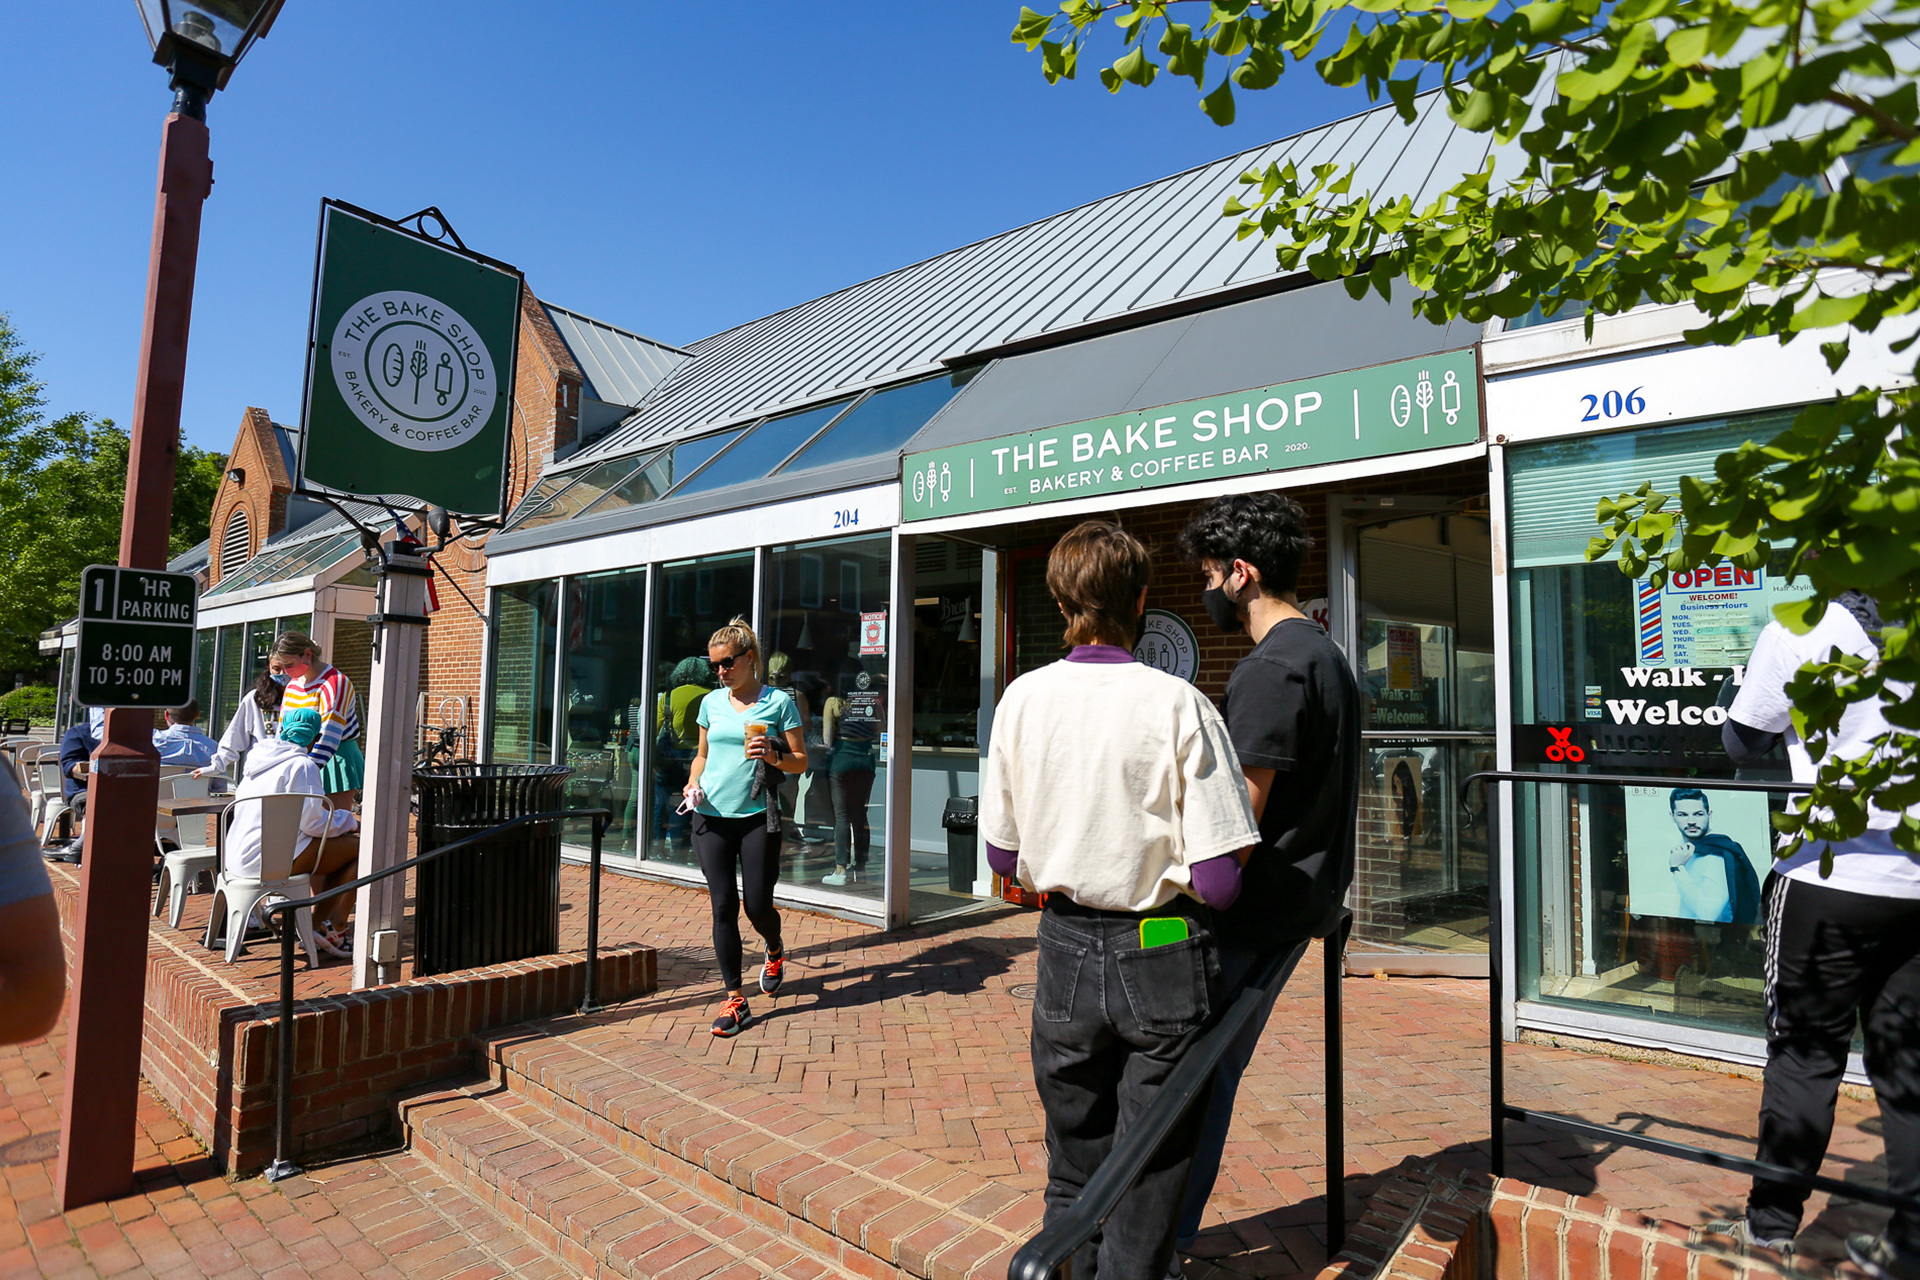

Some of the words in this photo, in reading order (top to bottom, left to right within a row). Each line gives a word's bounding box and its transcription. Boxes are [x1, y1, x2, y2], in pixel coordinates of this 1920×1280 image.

[344, 307, 381, 342] THE
[382, 301, 444, 326] BAKE
[447, 324, 485, 380] SHOP
[345, 371, 388, 425] BAKERY
[390, 423, 400, 434] &
[405, 425, 461, 441] COFFEE
[460, 405, 482, 429] BAR
[1580, 385, 1646, 422] 206
[991, 438, 1059, 476] THE
[1072, 416, 1177, 463] BAKE
[1192, 391, 1323, 442] SHOP
[1004, 486, 1018, 495] EST.
[1030, 468, 1104, 494] BAKERY
[1111, 465, 1123, 482] &
[1130, 451, 1215, 479] COFFEE
[1222, 443, 1269, 465] BAR
[833, 508, 859, 529] 204
[144, 580, 171, 598] HR
[1673, 567, 1754, 588] OPEN
[94, 578, 104, 611] 1
[1689, 593, 1738, 601] WELCOME!
[122, 600, 190, 620] PARKING
[1165, 624, 1188, 654] SHOP
[102, 643, 143, 662] 8:00
[149, 646, 172, 663] AM
[89, 667, 108, 684] TO
[115, 668, 154, 685] 5:00
[161, 669, 182, 686] PM
[1620, 665, 1707, 687] Walk
[1605, 699, 1728, 726] Welco
